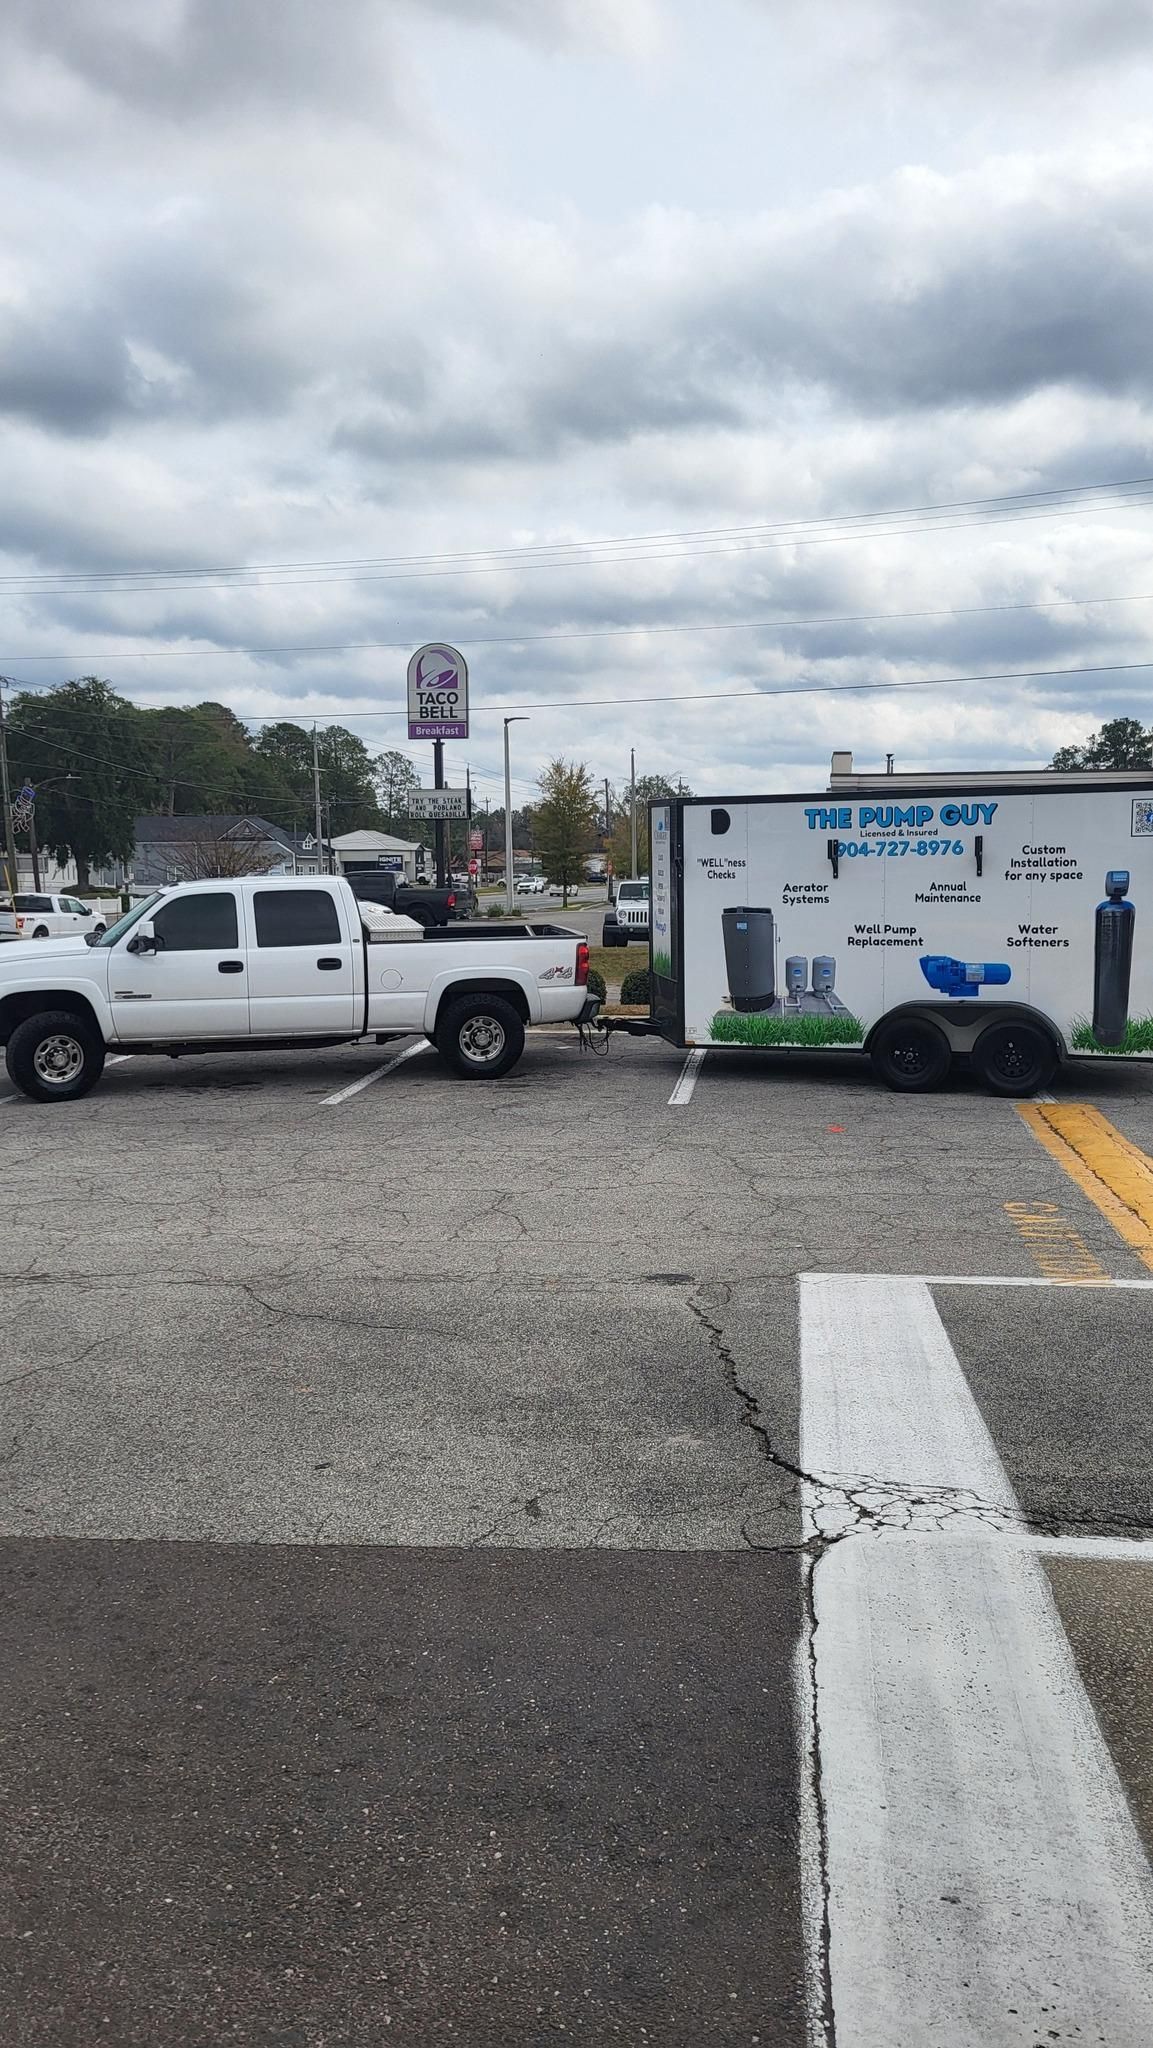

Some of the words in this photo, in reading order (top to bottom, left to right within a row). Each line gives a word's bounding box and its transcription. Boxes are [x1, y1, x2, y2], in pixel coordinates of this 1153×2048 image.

[416, 692, 459, 705] TACO
[419, 706, 458, 719] BELL
[415, 726, 459, 735] Breakfast
[805, 807, 852, 829] THE
[859, 805, 934, 828] PUMP
[940, 803, 998, 826] GUY
[860, 829, 896, 838] Licensed
[906, 829, 938, 837] Insured
[837, 840, 964, 857] 904-727-8976
[1022, 845, 1066, 855] Custom
[697, 858, 746, 868] "WELL"ness
[1010, 857, 1077, 868] Installation
[707, 870, 736, 879] Checks
[1005, 870, 1022, 881] for
[1025, 872, 1047, 883] any
[1050, 871, 1083, 883] space
[783, 883, 829, 892] Aerator
[929, 881, 967, 891] Annual
[782, 894, 830, 906] Systems
[915, 893, 981, 903] Maintenance
[854, 924, 880, 934] Well
[884, 924, 917, 937] Pump
[1018, 924, 1059, 934] Water
[847, 936, 923, 948] Replacement
[1007, 936, 1069, 947] Softeners
